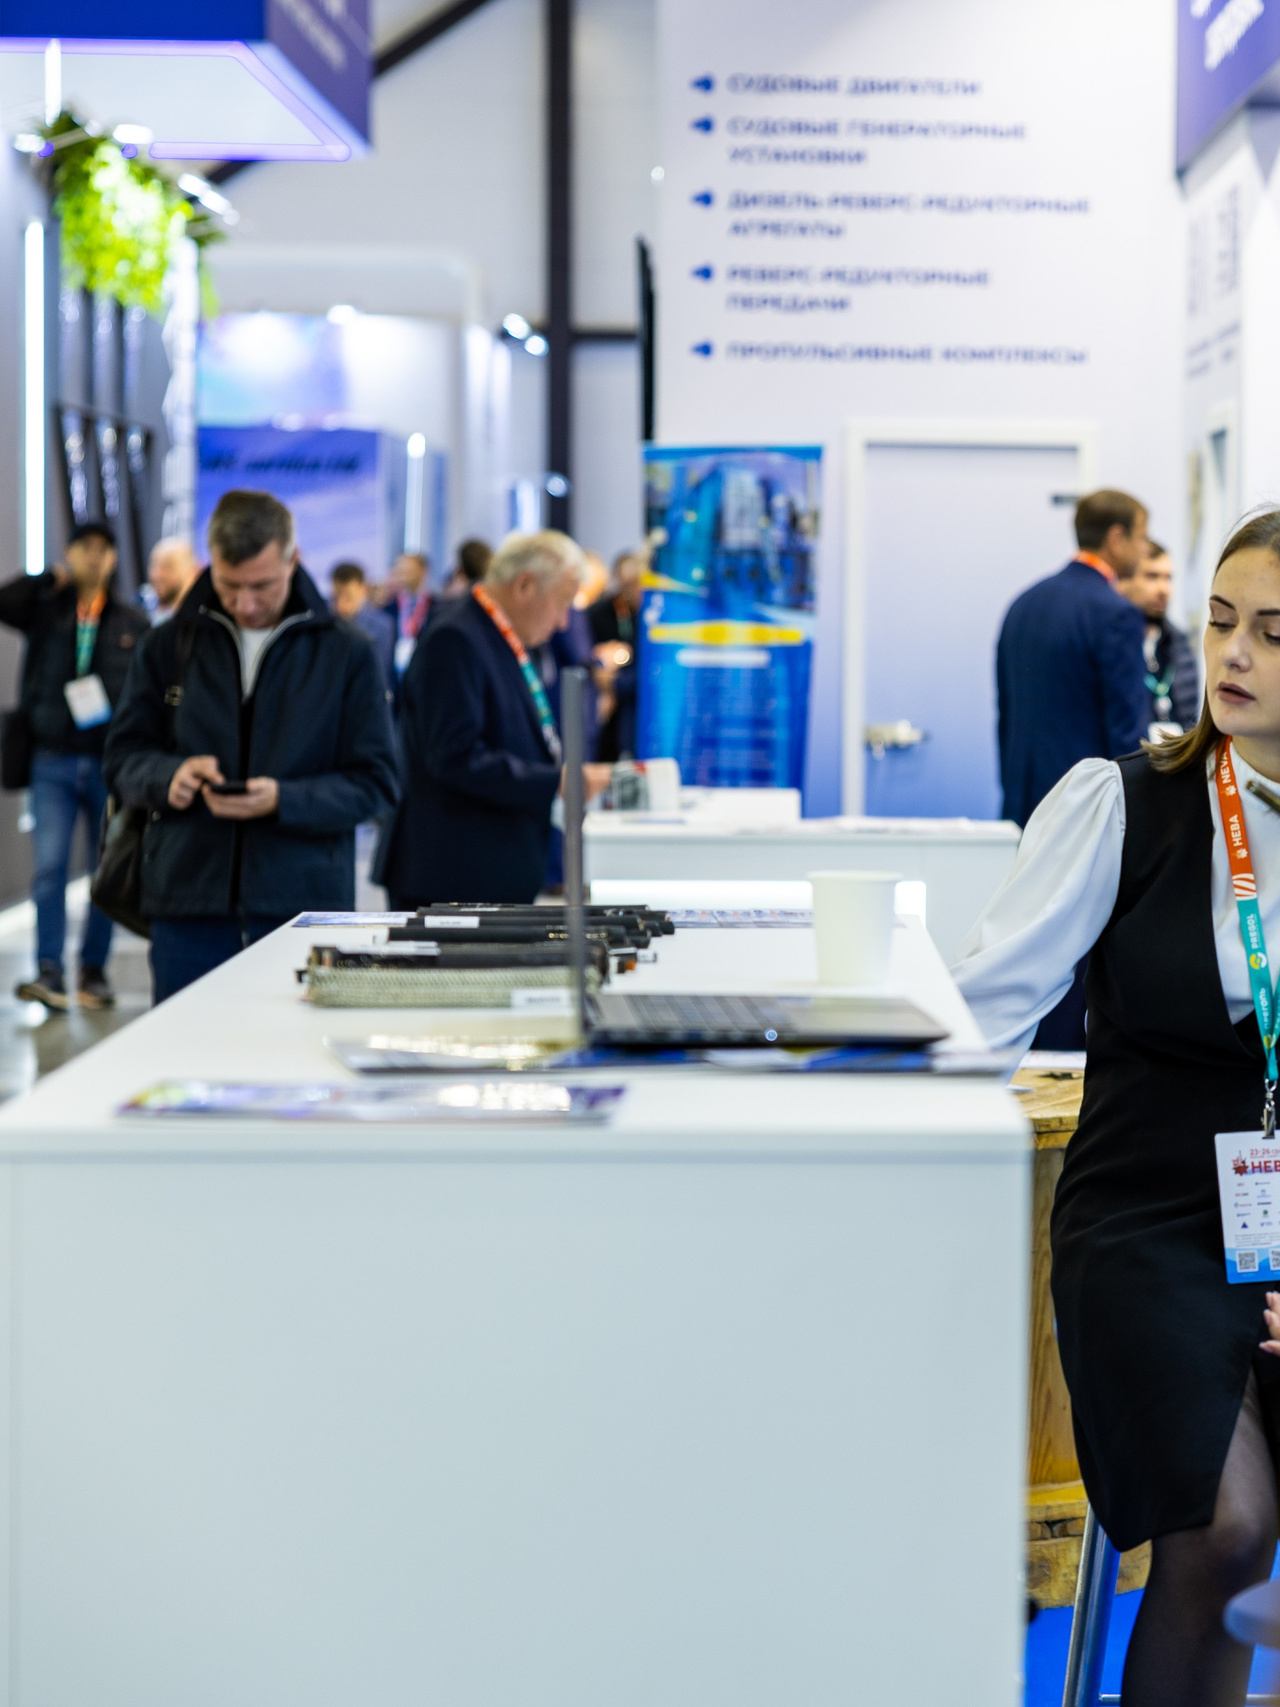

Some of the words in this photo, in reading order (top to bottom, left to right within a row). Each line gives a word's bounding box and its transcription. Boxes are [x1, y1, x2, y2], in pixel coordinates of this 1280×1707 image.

[727, 73, 839, 96] СУДОВЫЕ
[845, 76, 980, 97] ДВИГАТЕЛИ
[727, 116, 839, 138] СУДОВЫЕ
[846, 119, 1026, 141] ГЕНЕРАТОРНЫЕ
[728, 145, 867, 166] УСТАНОВКИ
[728, 219, 845, 239] АГРЕГАТЫ
[727, 293, 850, 315] ПЕРЕДАЧИ
[726, 342, 933, 363] ПРОПУЛЬСИВНЫЕ
[941, 346, 1088, 365] КОМПЛЕКСЫ
[1247, 913, 1259, 949] PREGOL
